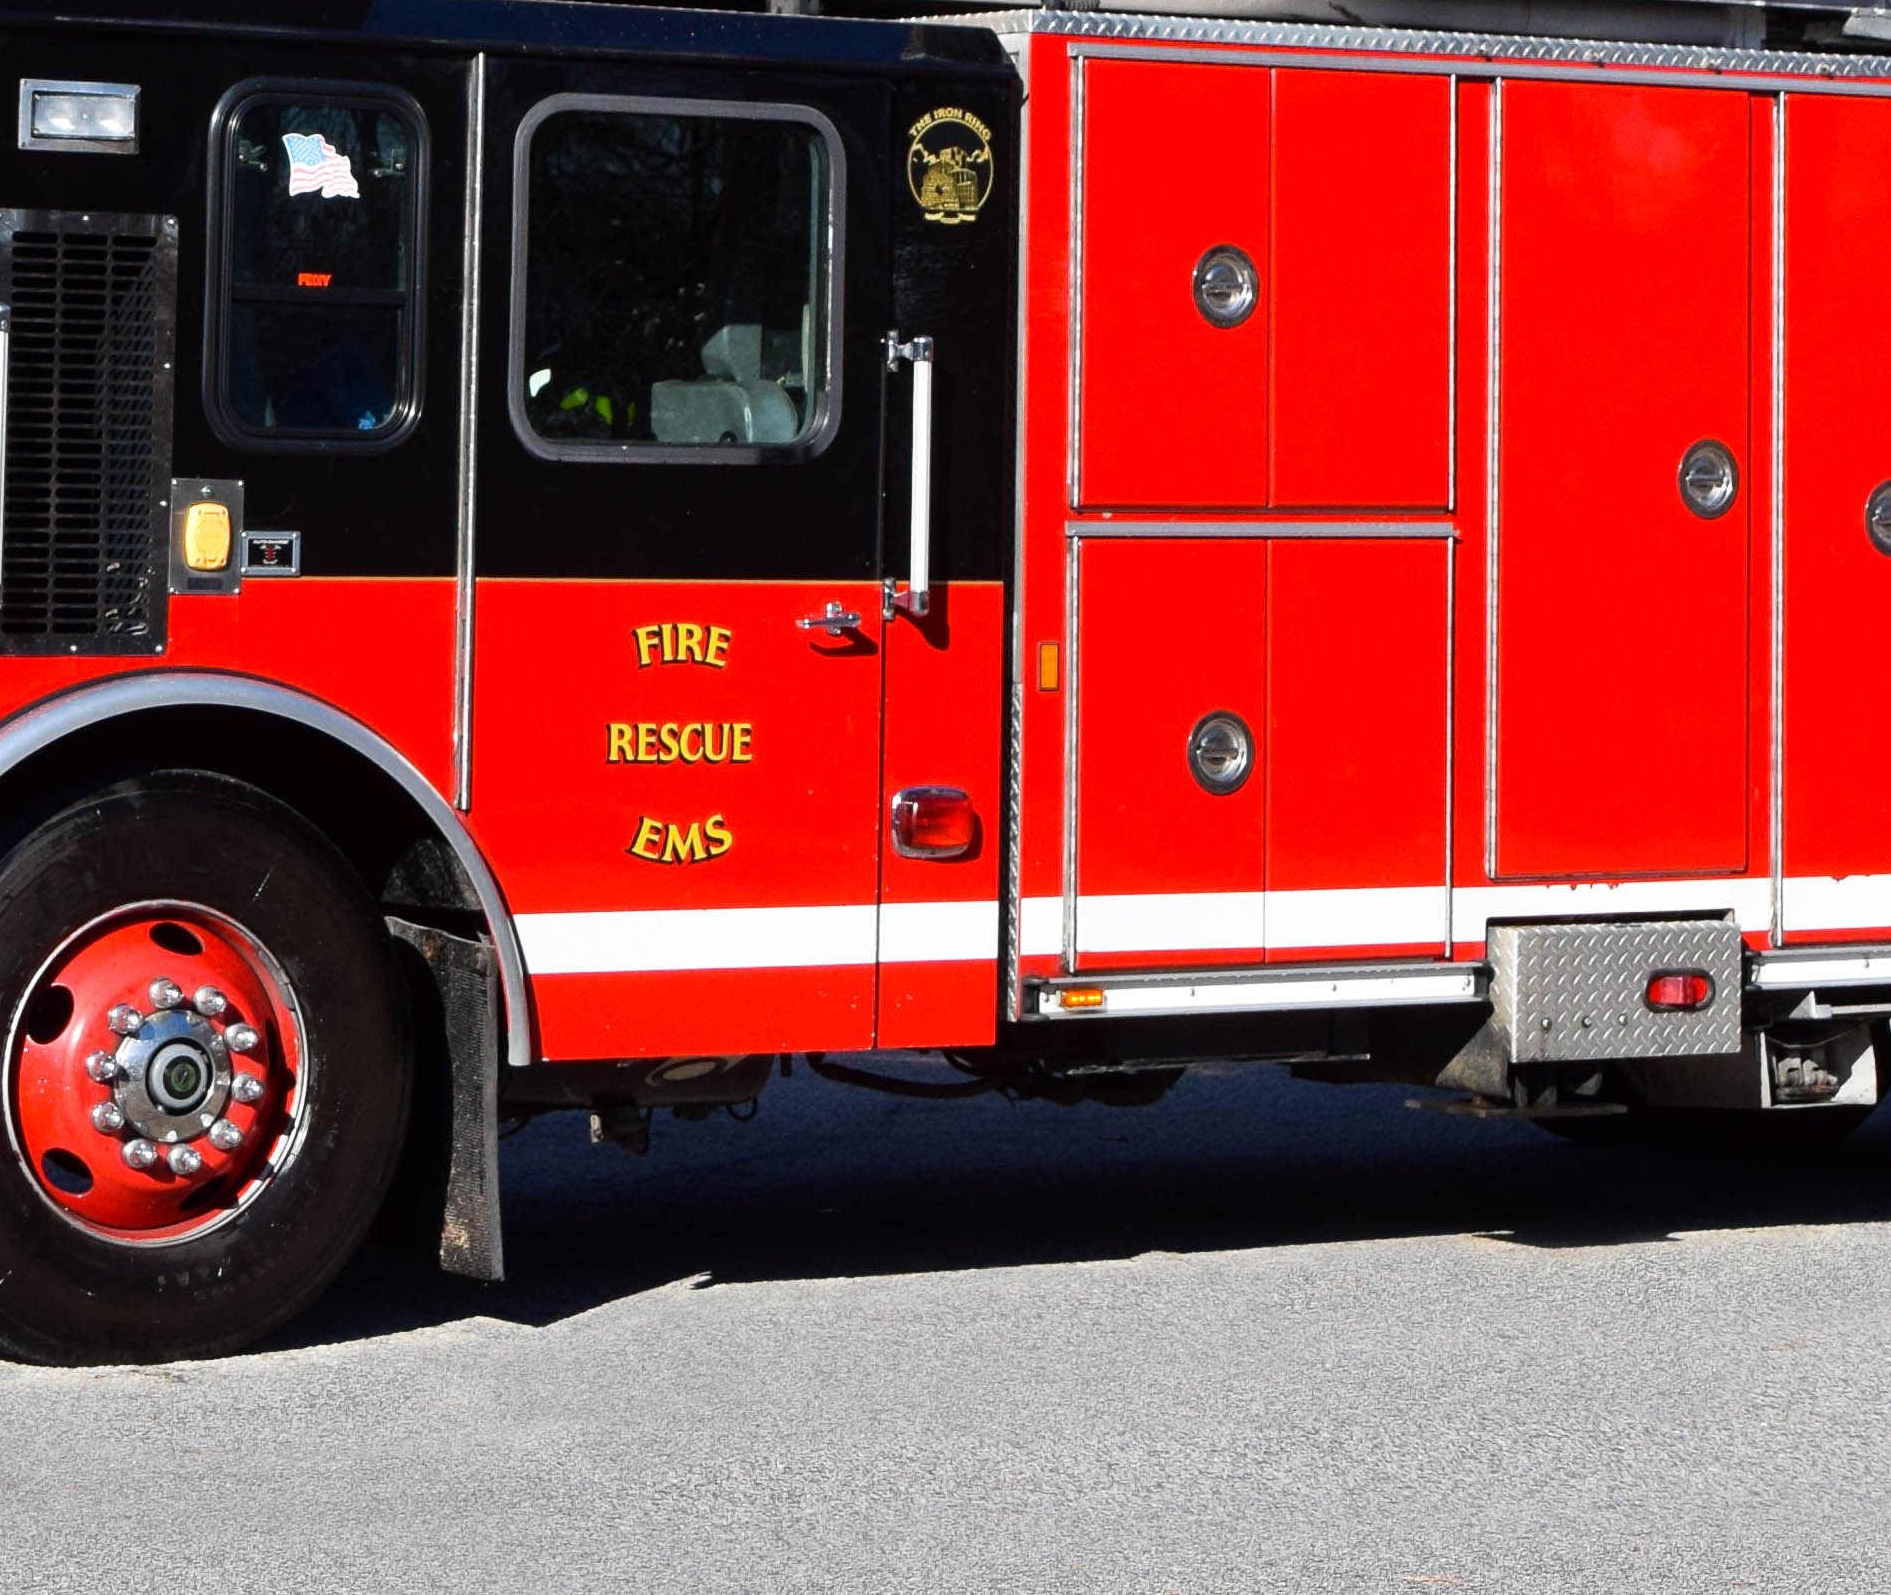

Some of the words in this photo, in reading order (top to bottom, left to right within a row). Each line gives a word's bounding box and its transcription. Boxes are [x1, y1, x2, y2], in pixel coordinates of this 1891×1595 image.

[909, 113, 932, 136] THE
[934, 107, 963, 119] IRON
[633, 623, 732, 669] FIRE
[606, 722, 752, 764] RESCUE
[626, 813, 733, 865] EMS
